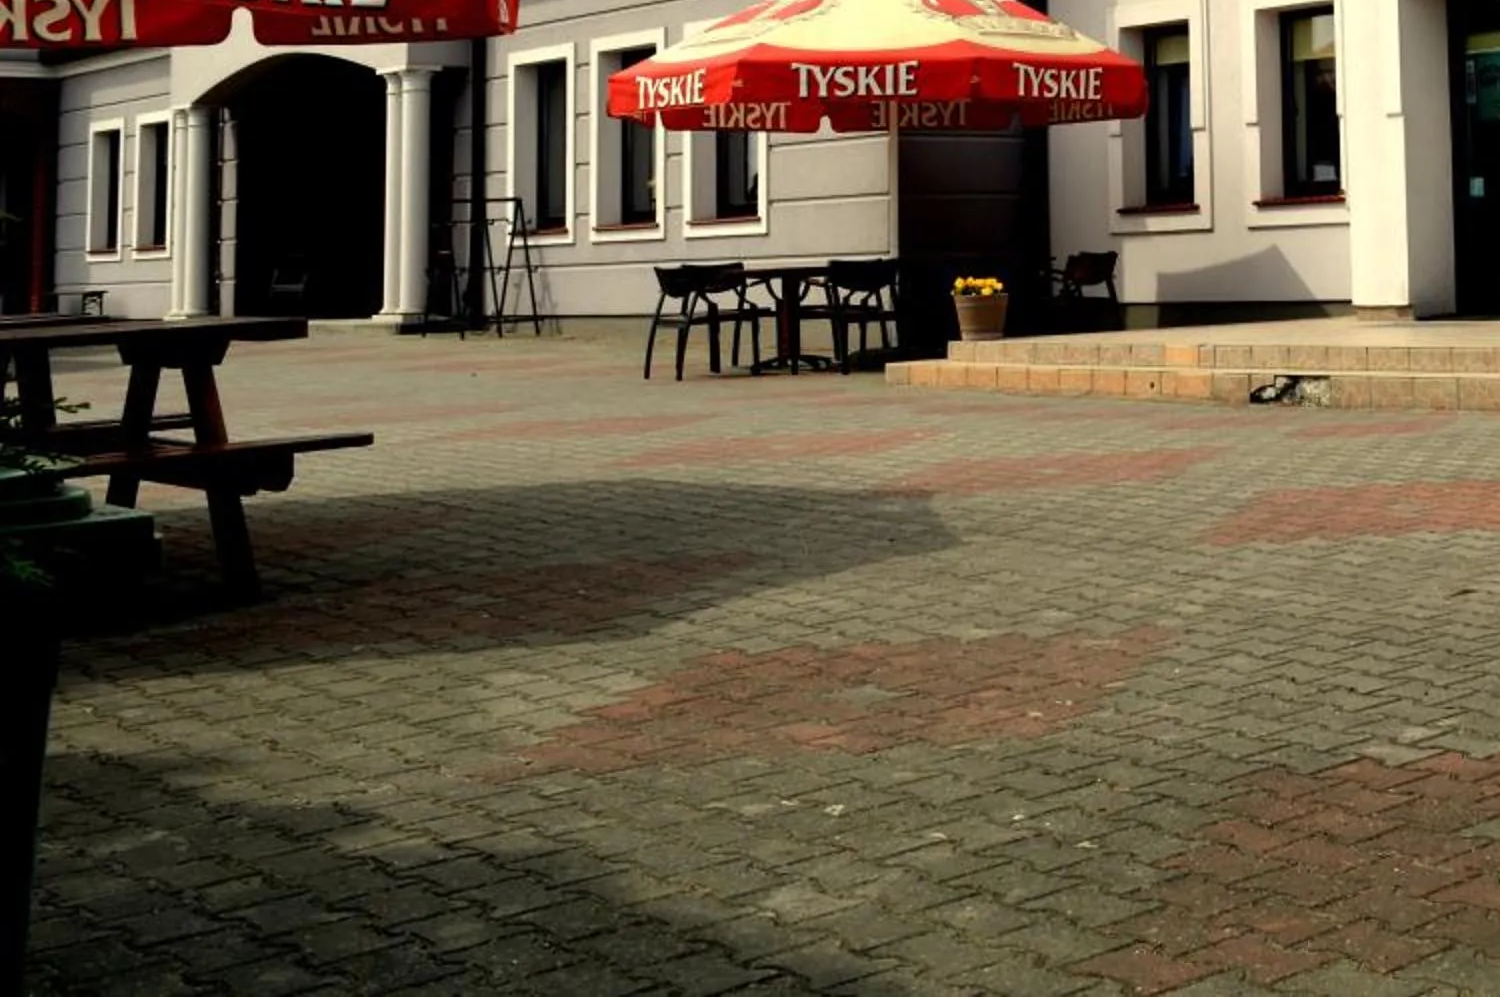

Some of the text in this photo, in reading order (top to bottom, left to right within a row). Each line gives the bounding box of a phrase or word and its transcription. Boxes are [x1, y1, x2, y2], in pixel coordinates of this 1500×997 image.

[635, 68, 706, 109] TYSKIE
[791, 60, 919, 98] TYSKIE
[1013, 62, 1103, 100] TYSKIE
